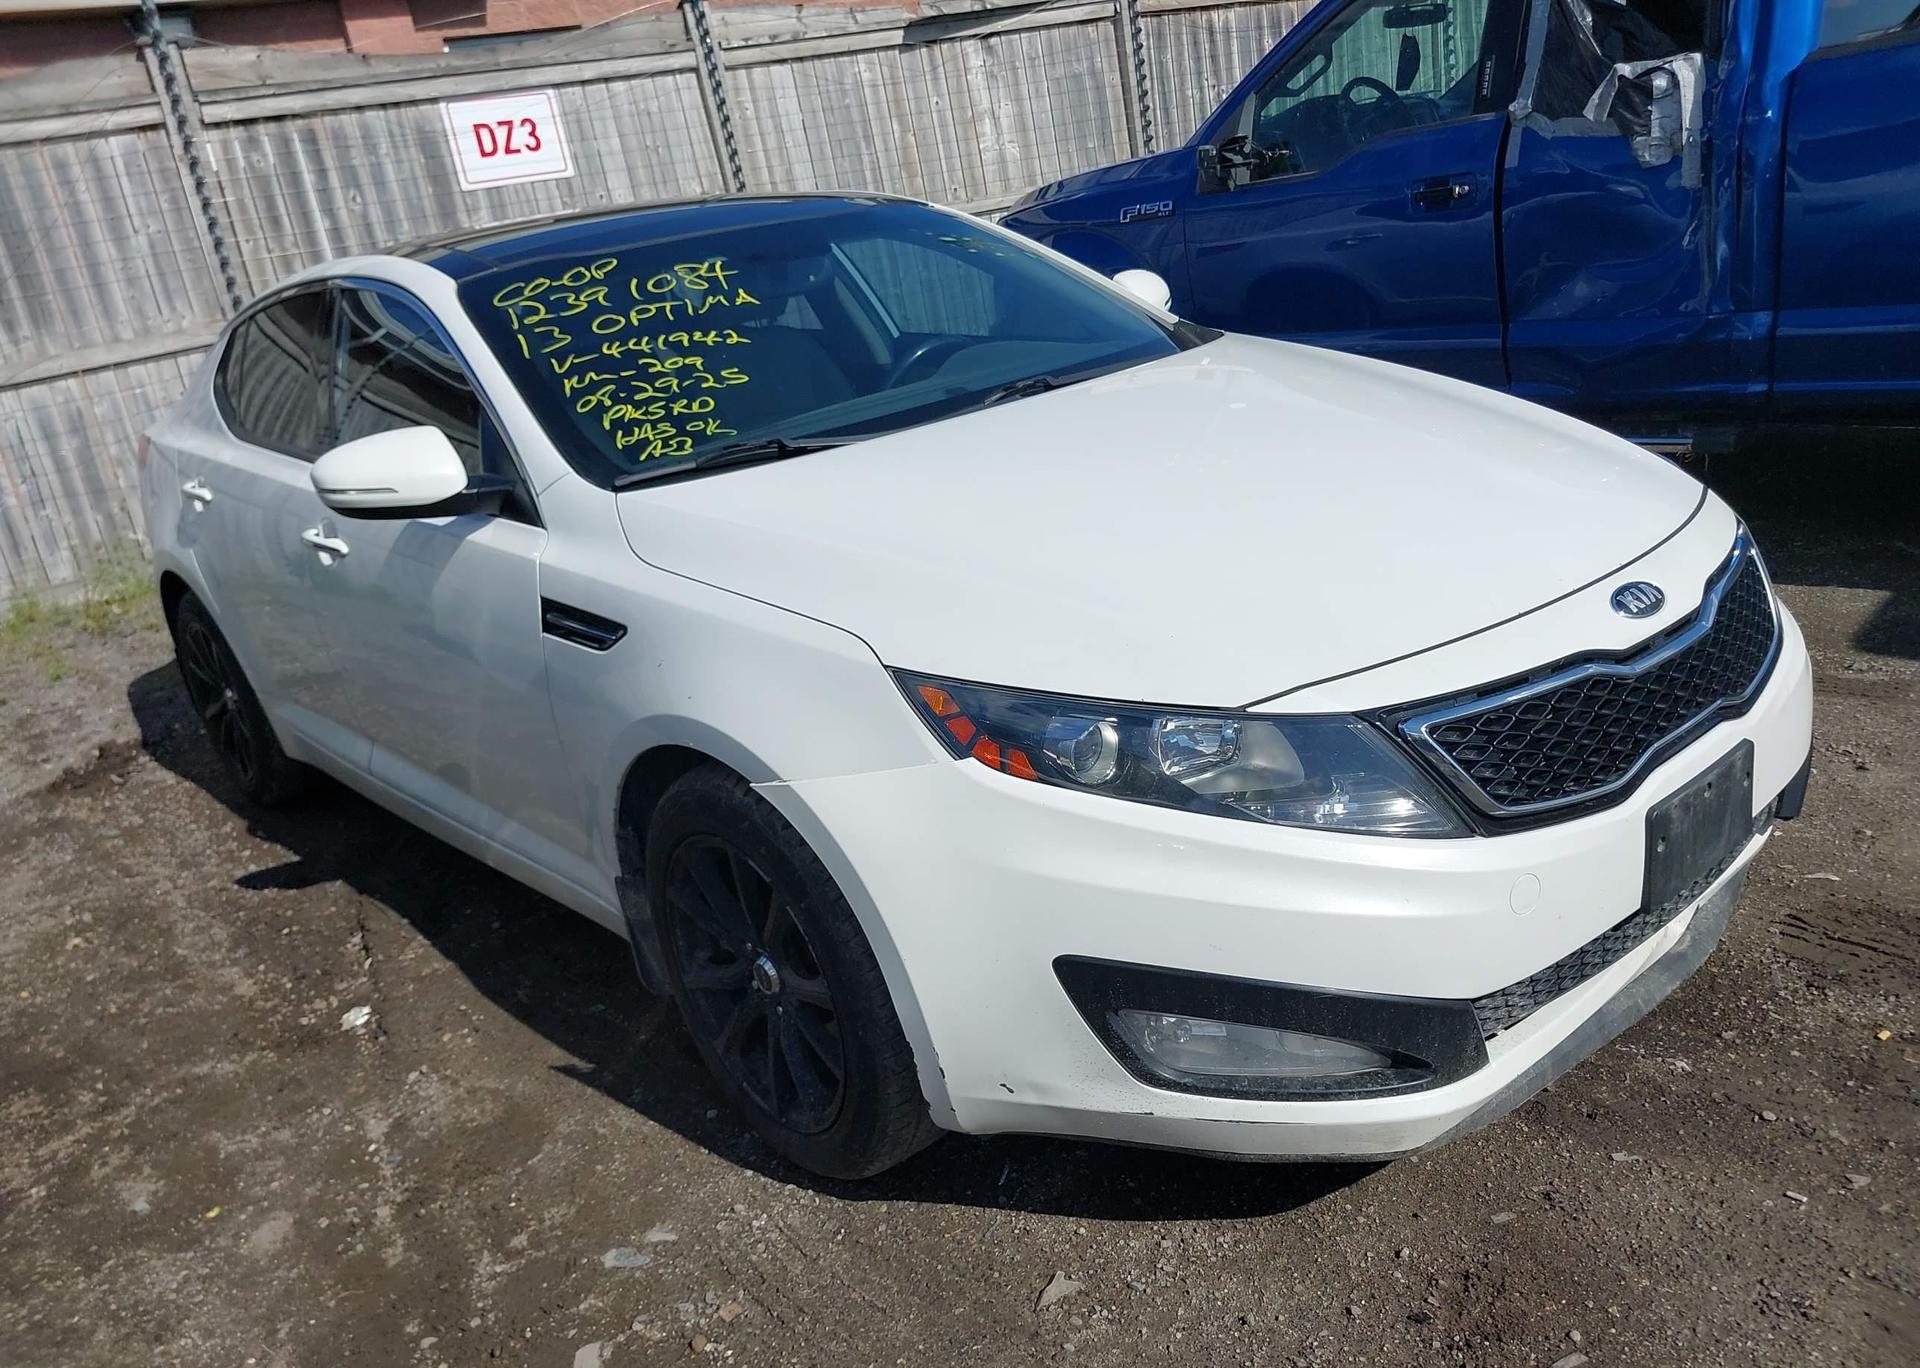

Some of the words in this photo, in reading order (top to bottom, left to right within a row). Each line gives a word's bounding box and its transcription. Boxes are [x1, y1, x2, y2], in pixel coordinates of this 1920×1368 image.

[473, 118, 541, 158] DZ3
[630, 257, 739, 301] 1084
[517, 325, 572, 359] 13
[591, 288, 761, 334] OPTIMA
[686, 418, 738, 436] OK
[1616, 584, 1662, 613] KIA
